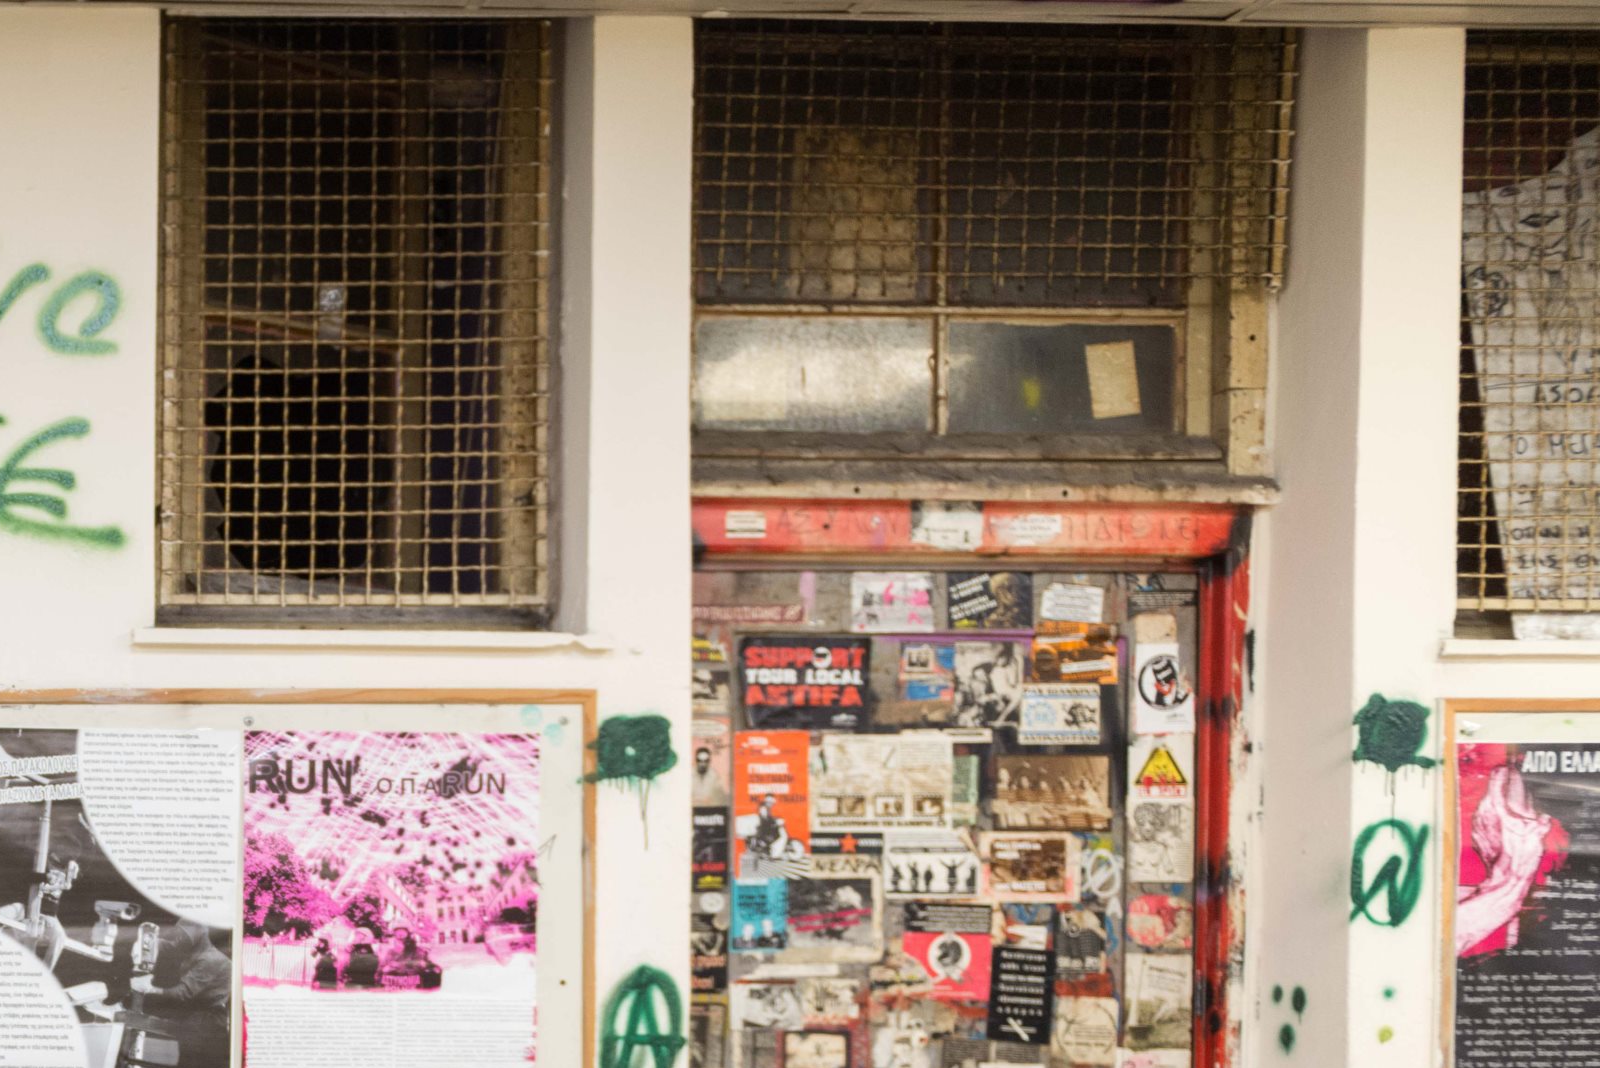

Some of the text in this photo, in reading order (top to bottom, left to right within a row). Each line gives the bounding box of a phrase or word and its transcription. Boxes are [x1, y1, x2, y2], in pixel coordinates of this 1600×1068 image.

[805, 668, 864, 685] LOCAL
[1522, 750, 1556, 773] ΑΠΟ
[249, 759, 352, 794] RUN
